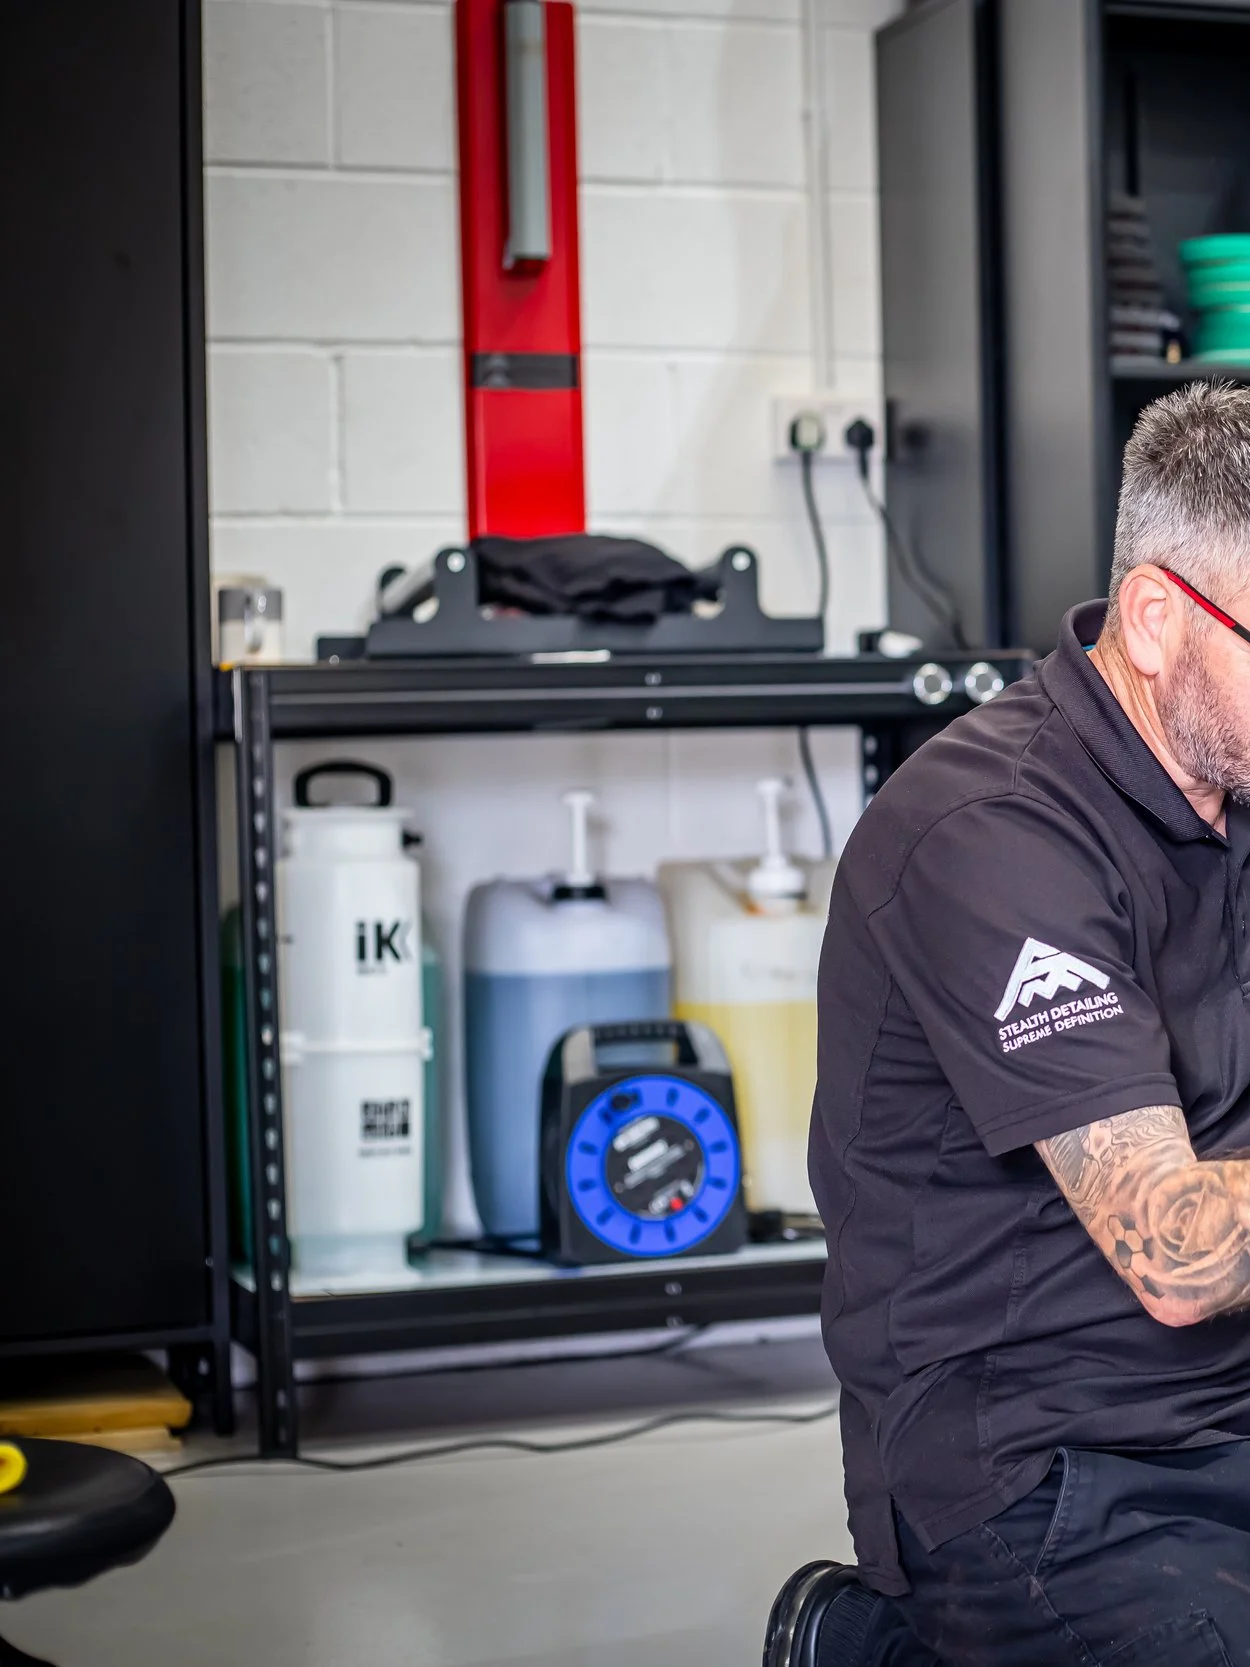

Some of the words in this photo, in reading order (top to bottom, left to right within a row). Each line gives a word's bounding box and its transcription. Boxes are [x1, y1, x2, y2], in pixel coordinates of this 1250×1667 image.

[998, 1010, 1050, 1040] STEALTH
[1050, 992, 1119, 1020] DETAILING
[1003, 1025, 1053, 1053] SUPREME
[1054, 1004, 1124, 1032] DEFINITION
